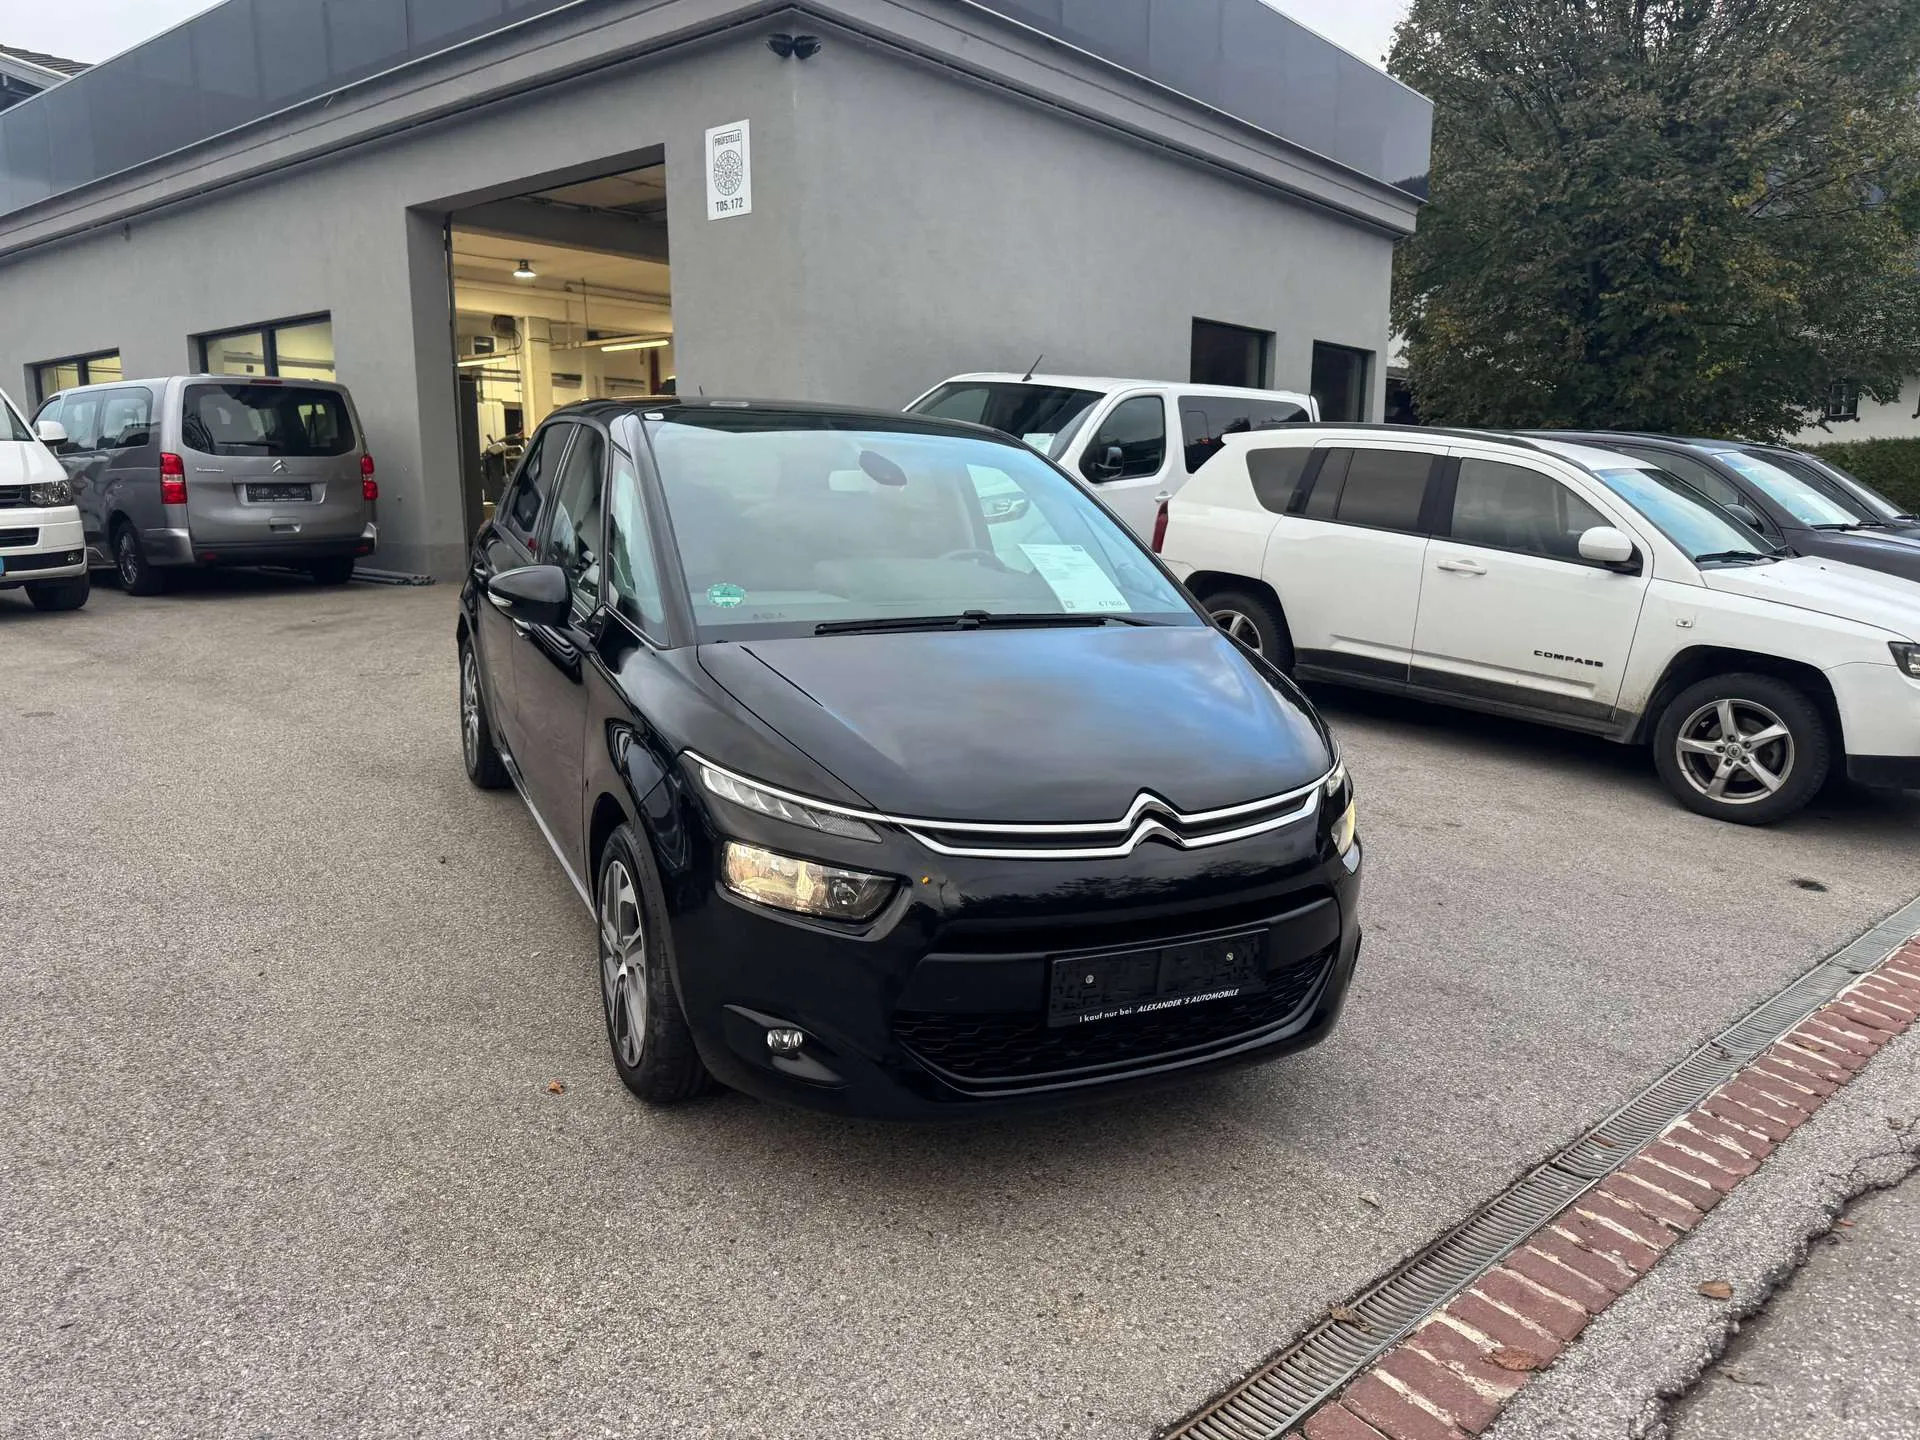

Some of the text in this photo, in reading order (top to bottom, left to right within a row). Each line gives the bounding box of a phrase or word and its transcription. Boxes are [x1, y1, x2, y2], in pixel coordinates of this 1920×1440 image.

[715, 197, 743, 213] T05.172
[1533, 650, 1604, 668] COMPASS
[1084, 1012, 1103, 1023] kauf
[1104, 1010, 1118, 1019] nur
[1119, 1007, 1132, 1017] bei
[1136, 998, 1182, 1014] ALEXANDER
[1190, 988, 1240, 1004] AUTOMOBILE
